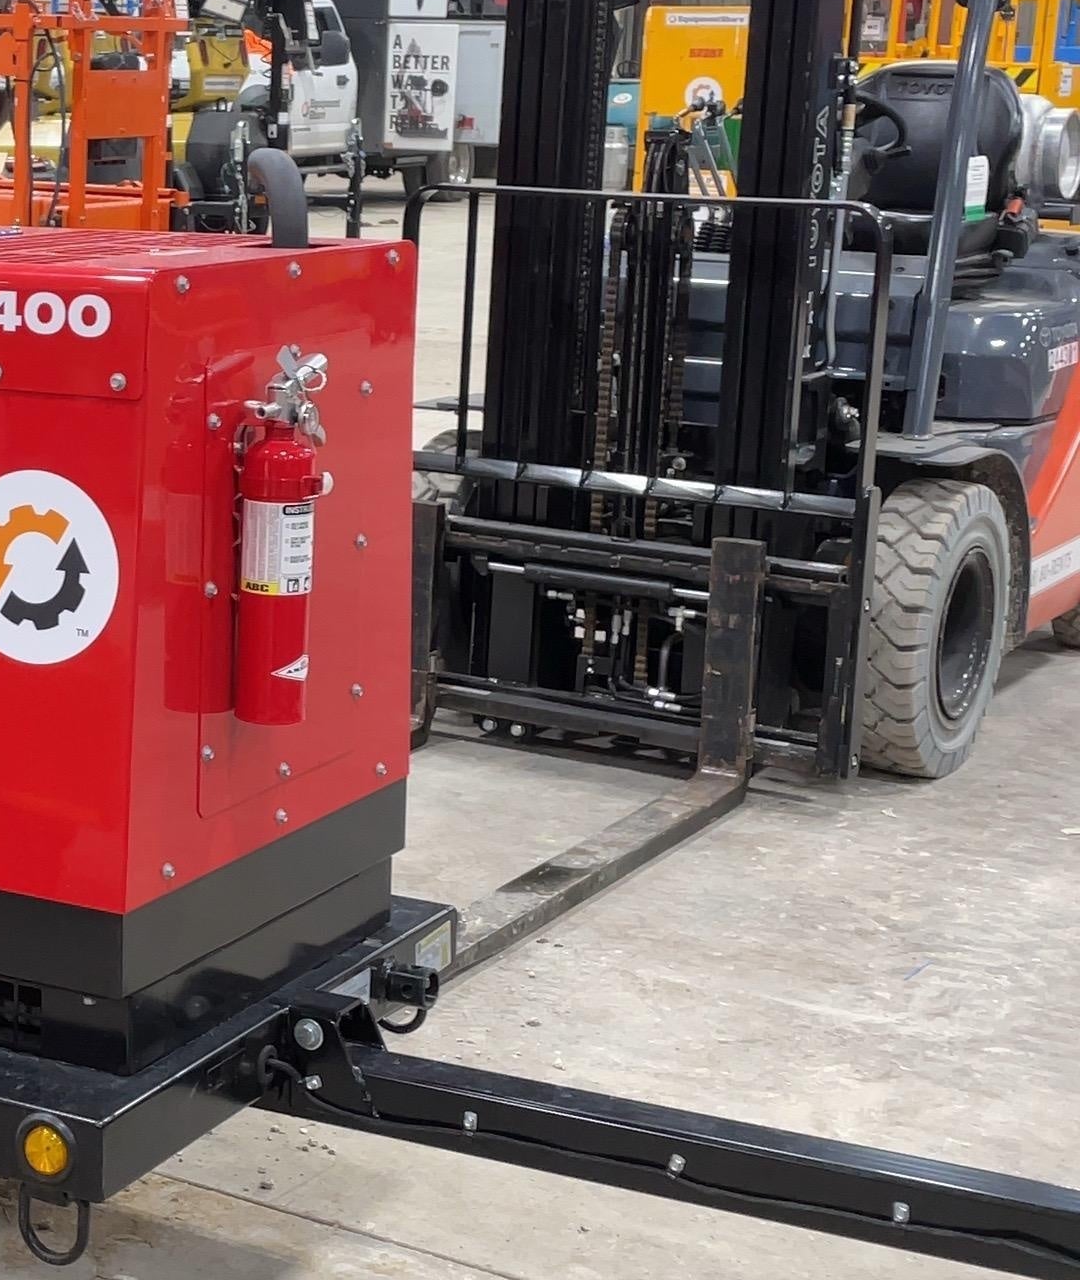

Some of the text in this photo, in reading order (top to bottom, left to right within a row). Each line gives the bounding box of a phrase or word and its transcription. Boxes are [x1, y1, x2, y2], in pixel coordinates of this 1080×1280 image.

[393, 34, 402, 49] A
[392, 54, 450, 70] BETTER
[245, 582, 269, 593] ABC
